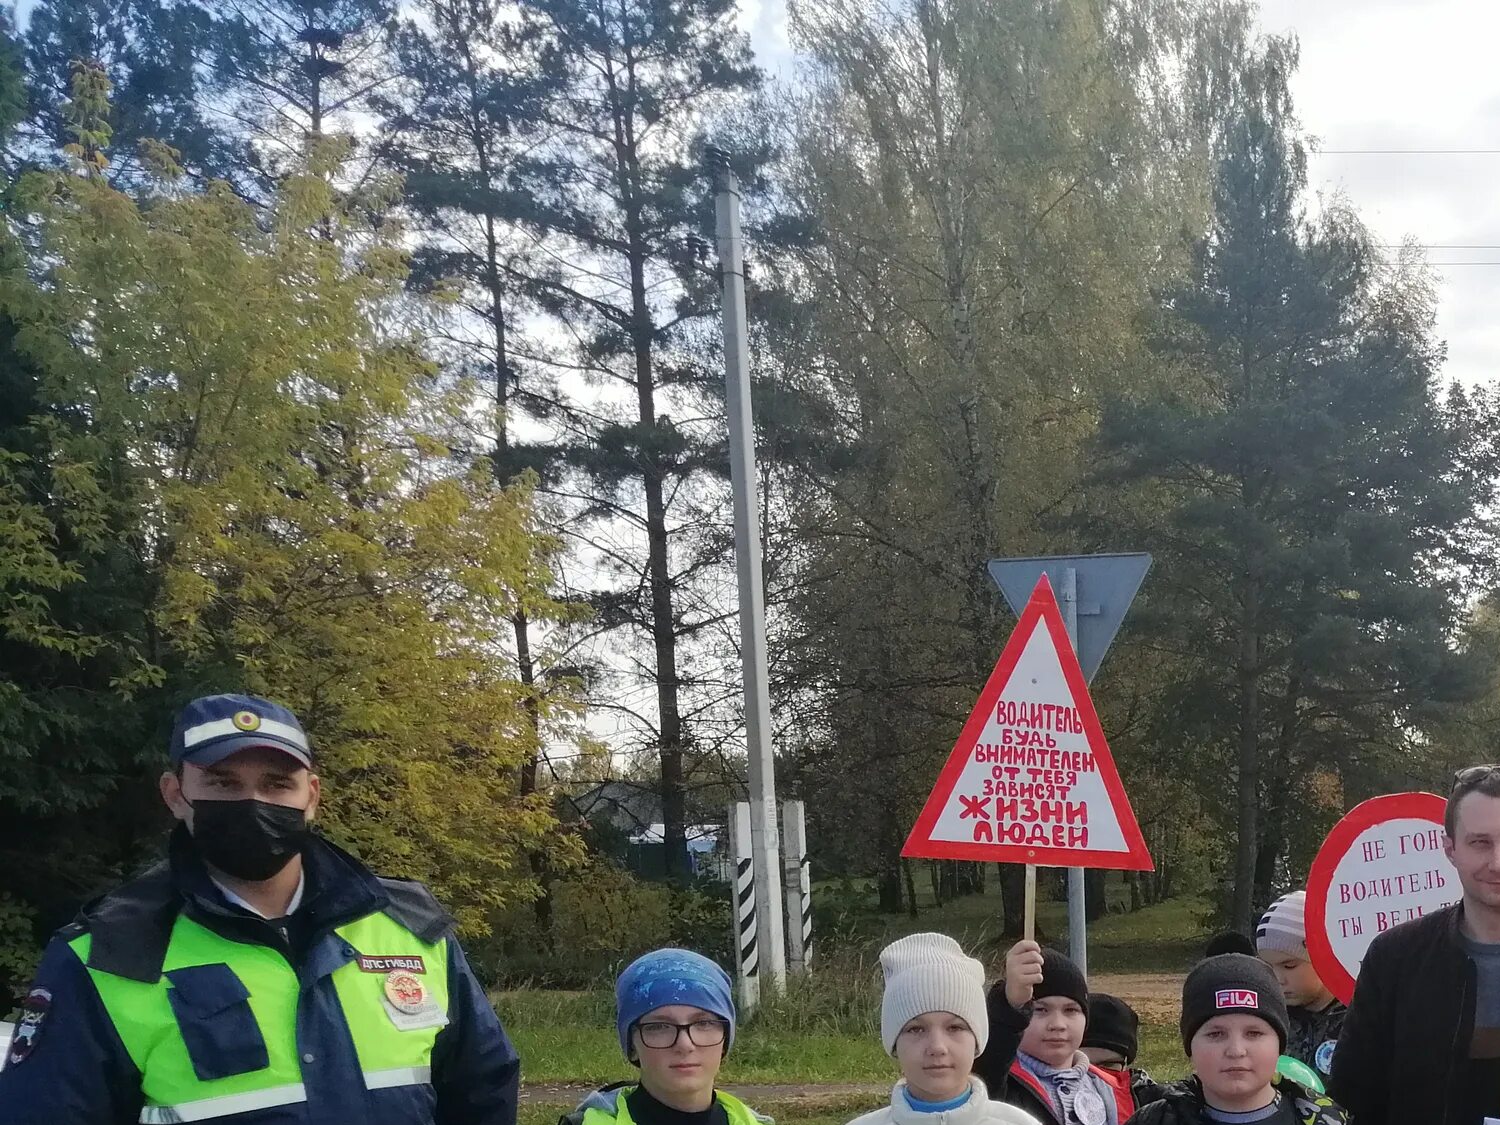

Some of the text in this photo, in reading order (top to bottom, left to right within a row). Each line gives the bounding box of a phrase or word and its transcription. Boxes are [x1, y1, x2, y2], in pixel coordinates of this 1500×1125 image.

[997, 700, 1082, 734] ВОДИТЕЛЬ
[1002, 728, 1056, 748] БУДЬ
[975, 744, 1094, 772] ВНИМАТЕЛЕН
[992, 766, 1077, 786] ОТ ТЕБЯ
[983, 779, 1071, 800] ЗАВИСЯТ
[959, 794, 1088, 825] ЖИЗНИ
[973, 821, 1088, 848] ЛЮДЕЙ
[1362, 829, 1444, 862] НЕ ГОН
[1339, 869, 1446, 904] ВОДИТЕЛЬ
[1338, 916, 1363, 938] ТЫ
[362, 958, 423, 971] ДПС ГИБДД
[1219, 992, 1255, 1006] FILA
